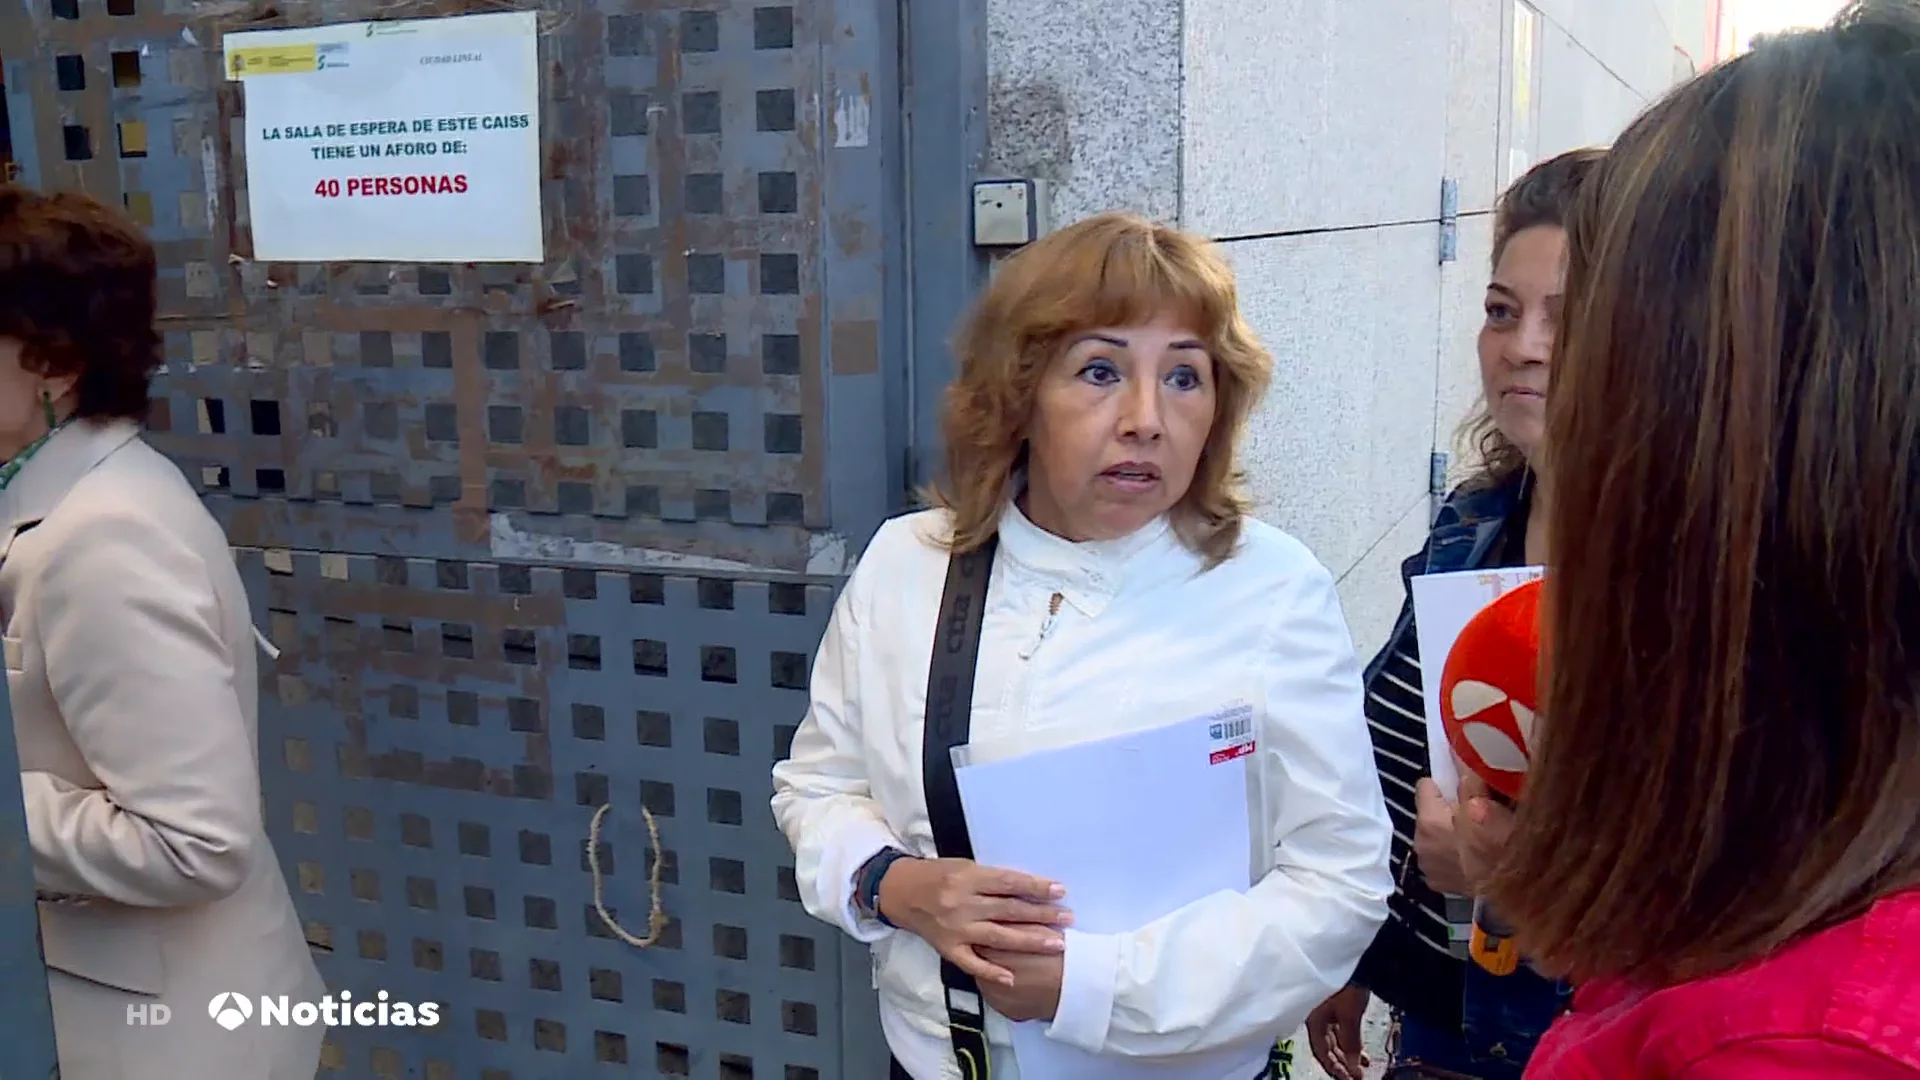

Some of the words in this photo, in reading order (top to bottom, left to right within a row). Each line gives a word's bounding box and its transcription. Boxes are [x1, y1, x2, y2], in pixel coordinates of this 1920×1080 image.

[262, 127, 281, 141] LA
[284, 125, 323, 140] SALA
[326, 123, 346, 138] DE
[349, 120, 408, 136] ESPERA
[412, 119, 433, 133] DE
[437, 116, 478, 132] ESTE
[481, 114, 529, 130] CAISS
[311, 145, 356, 160] TIENE
[359, 144, 381, 158] UN
[384, 142, 437, 157] AFORO
[442, 140, 467, 154] DE:
[314, 179, 340, 198] 40
[347, 174, 468, 197] PERSONAS
